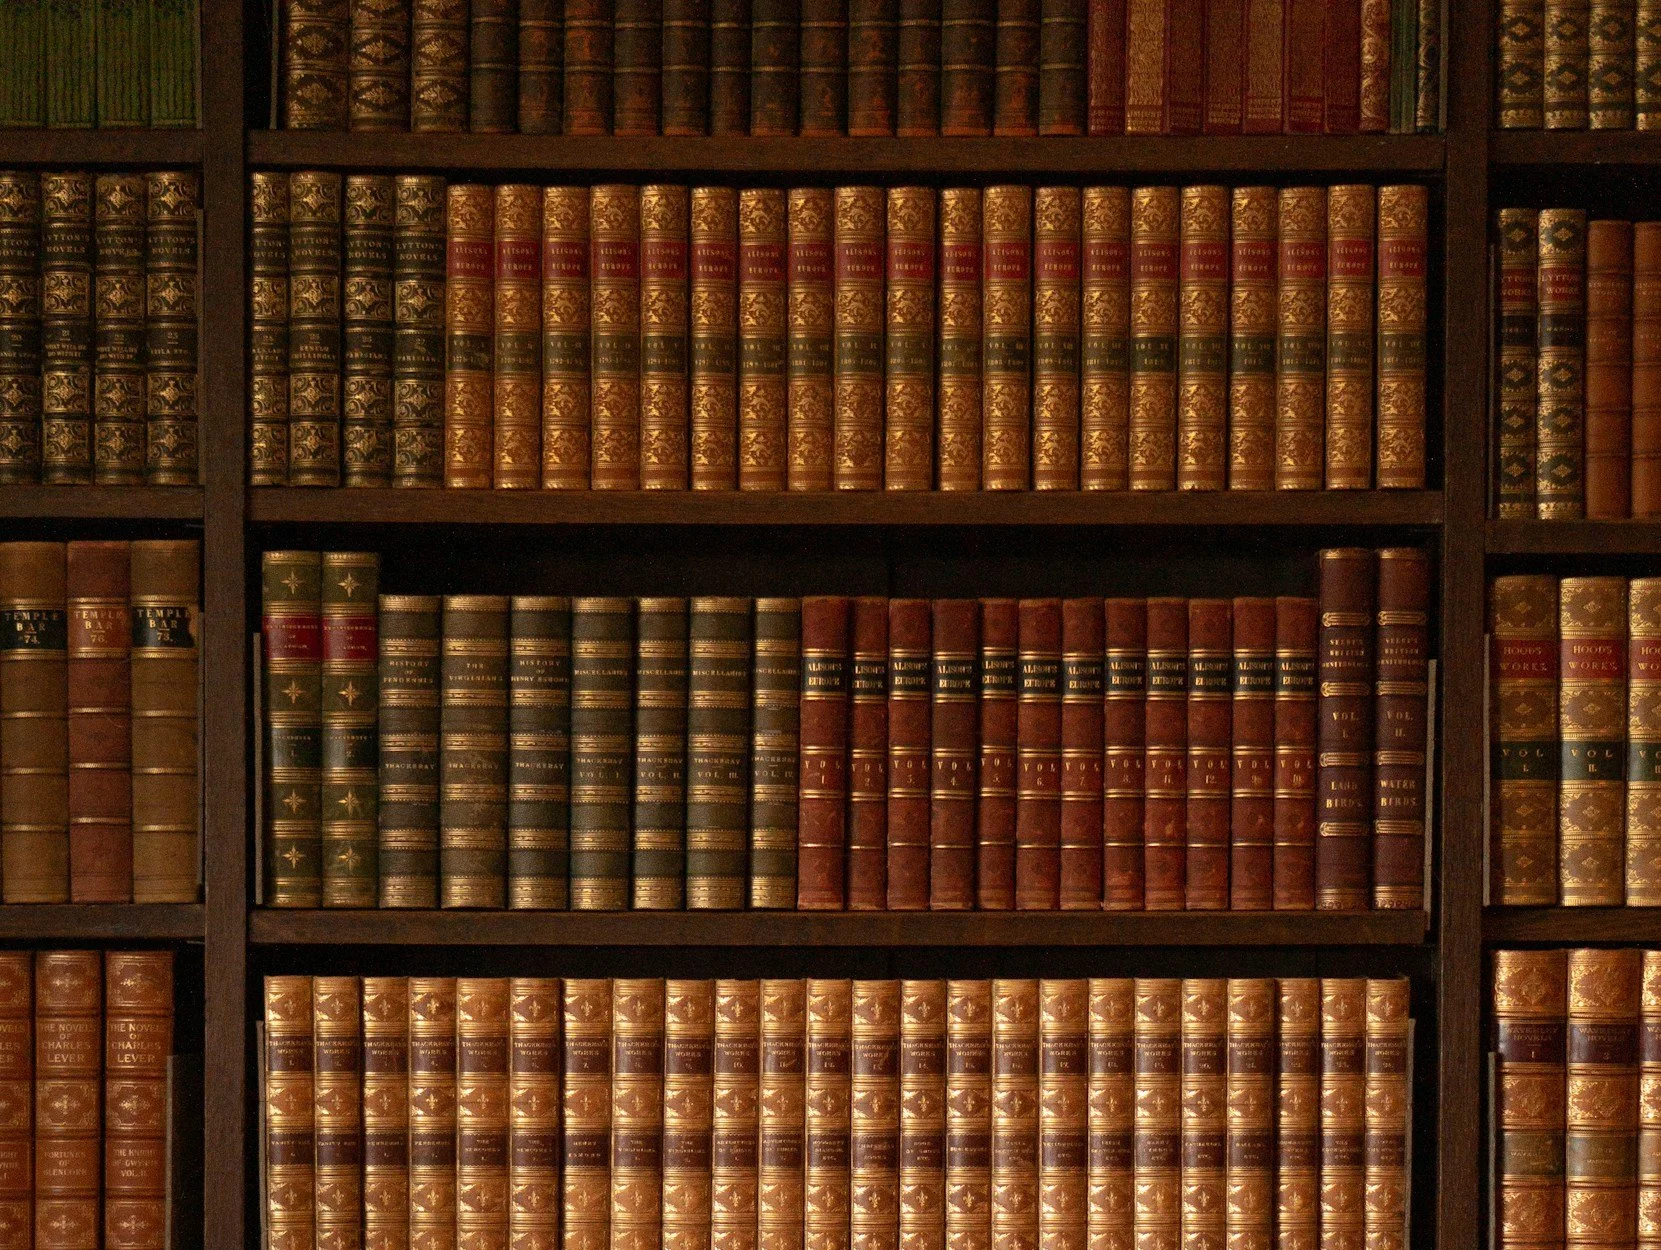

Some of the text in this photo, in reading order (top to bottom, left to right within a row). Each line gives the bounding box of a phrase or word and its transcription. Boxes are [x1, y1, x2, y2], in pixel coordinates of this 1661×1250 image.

[4, 611, 59, 622] TEMPLE
[74, 609, 123, 620] TEMPLE
[16, 622, 47, 632] BAR
[85, 620, 113, 630] BAR
[150, 619, 178, 629] BAR
[1380, 779, 1415, 789] WATER
[42, 1041, 91, 1050] CHARLES
[111, 1041, 162, 1050] CHARLES
[47, 1054, 85, 1063] LEVER
[117, 1053, 156, 1063] LEVER
